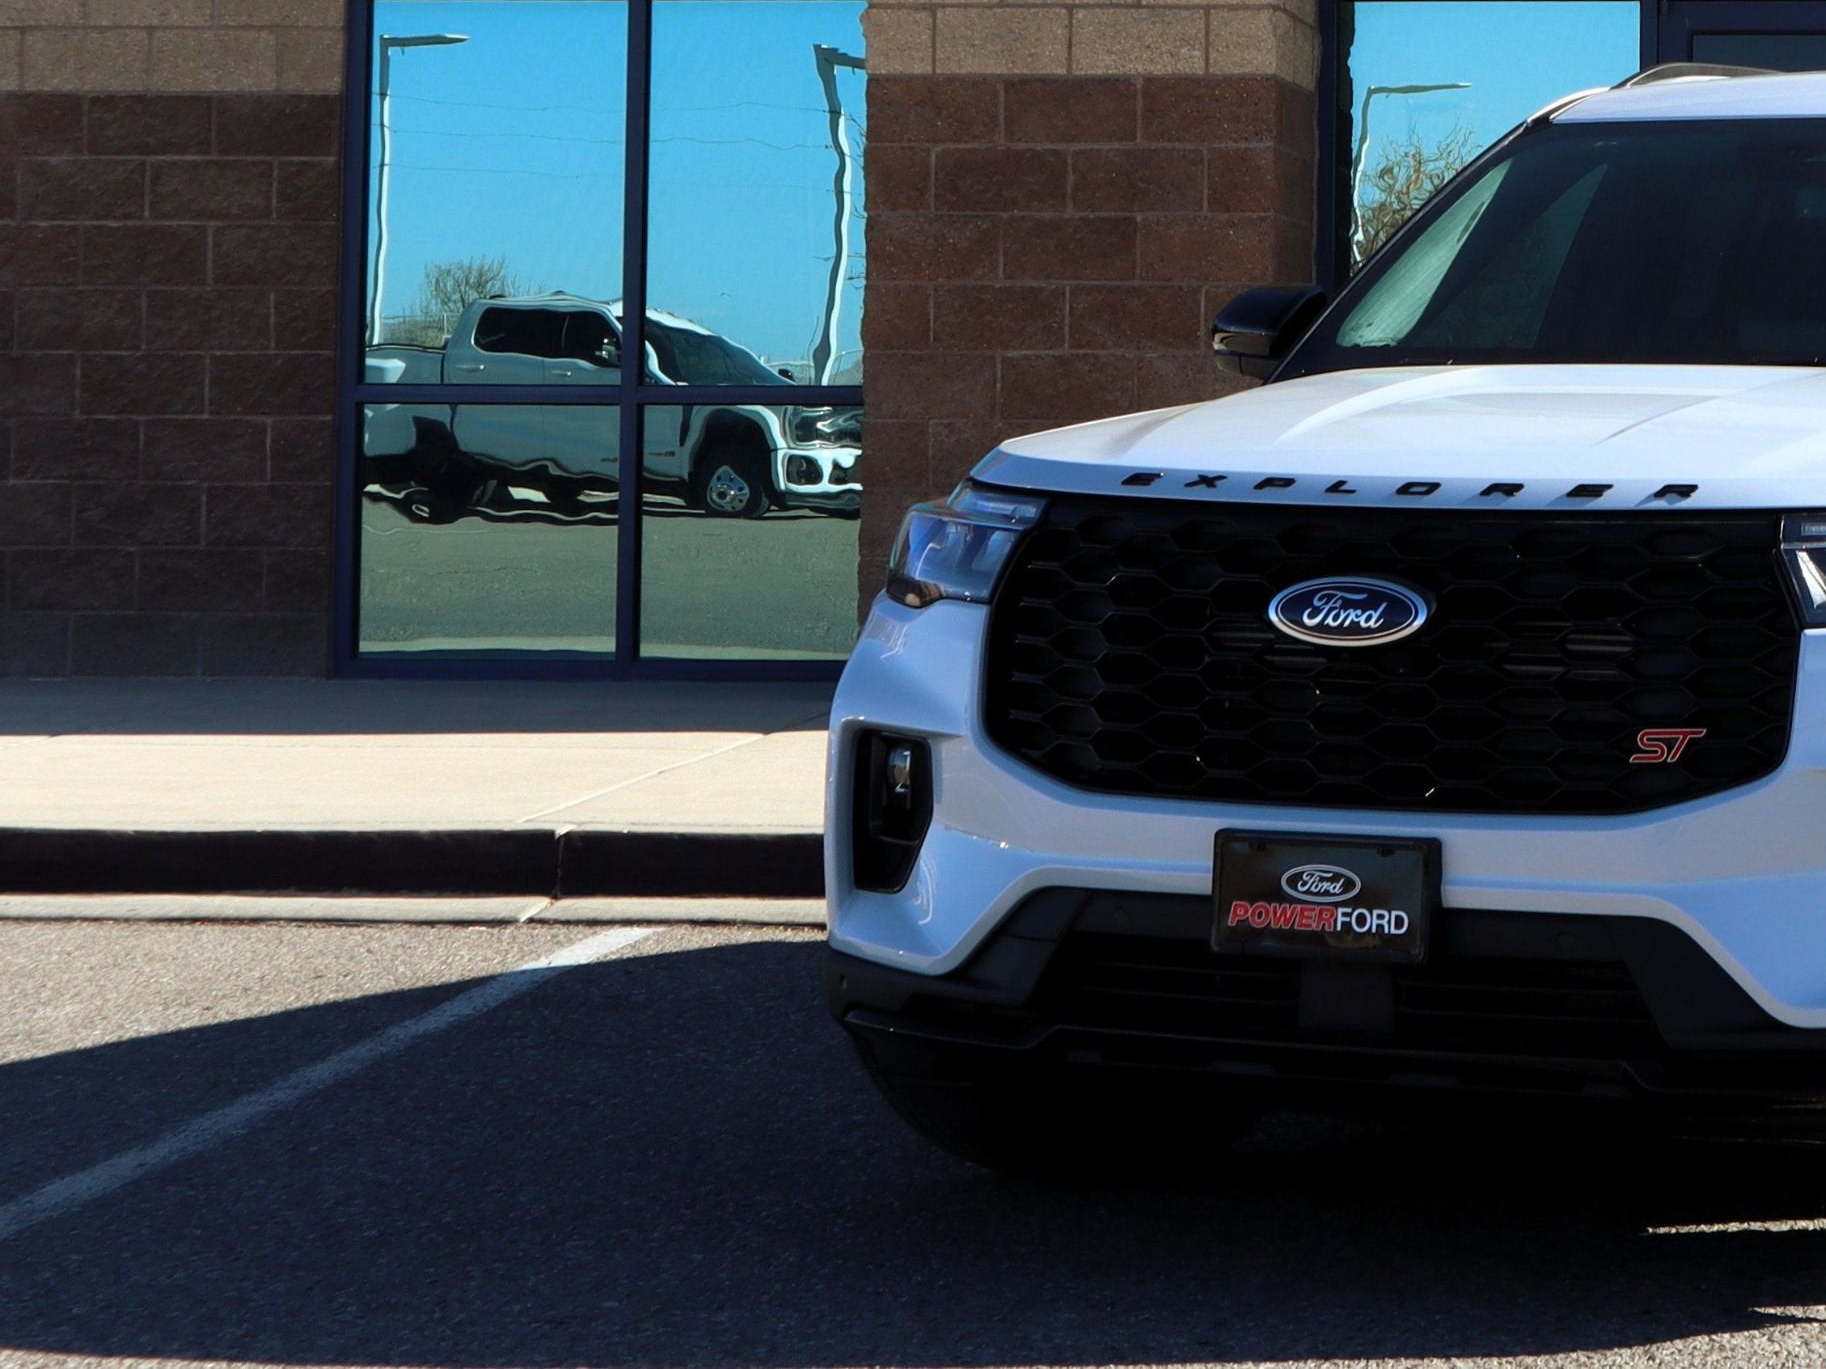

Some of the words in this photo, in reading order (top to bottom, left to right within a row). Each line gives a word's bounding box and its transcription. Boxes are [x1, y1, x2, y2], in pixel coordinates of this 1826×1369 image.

[1121, 471, 1699, 499] EXPLORER
[1302, 590, 1388, 629] Ford
[1629, 728, 1707, 763] ST
[1297, 870, 1345, 895] Ford
